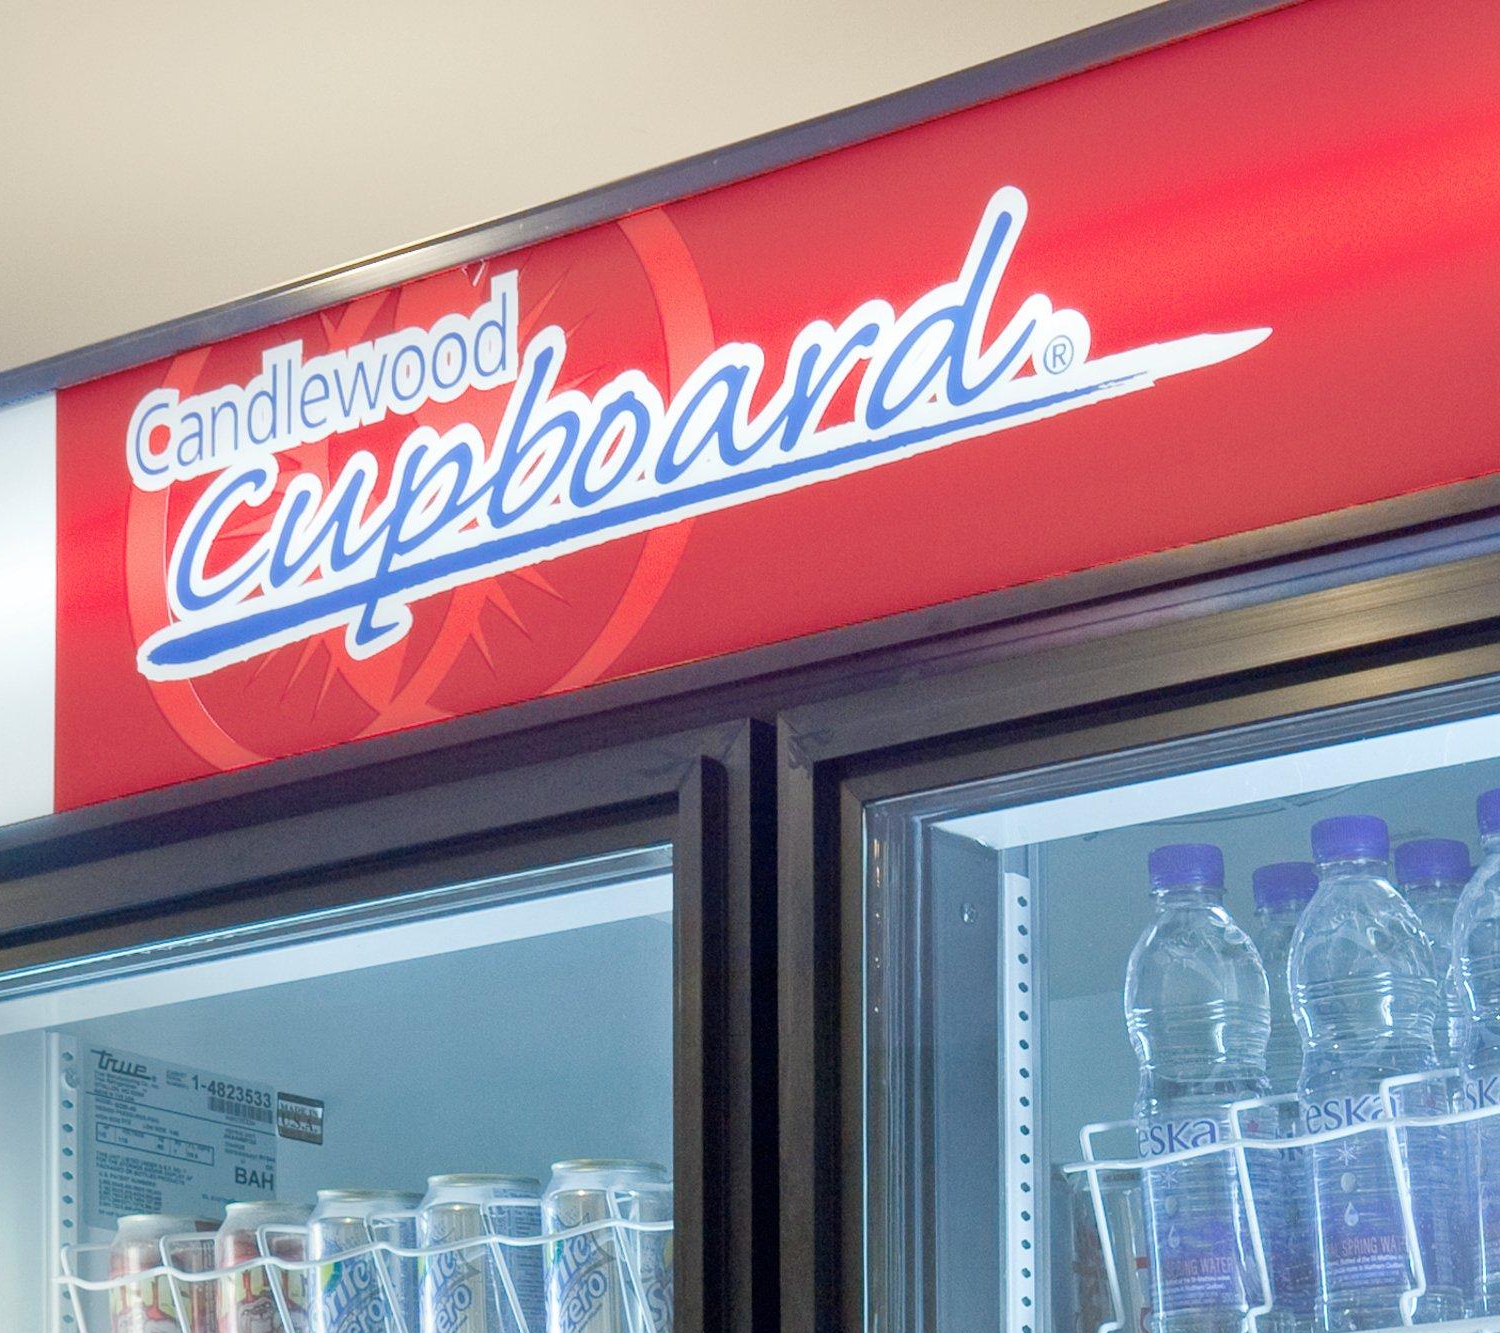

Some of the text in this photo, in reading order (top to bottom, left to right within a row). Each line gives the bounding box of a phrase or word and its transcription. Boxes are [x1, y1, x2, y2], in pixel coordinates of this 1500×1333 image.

[136, 282, 513, 476] Candlewood
[173, 209, 1034, 642] Cupboard
[192, 1075, 271, 1108] 1-4823533
[235, 1167, 274, 1190] BAH
